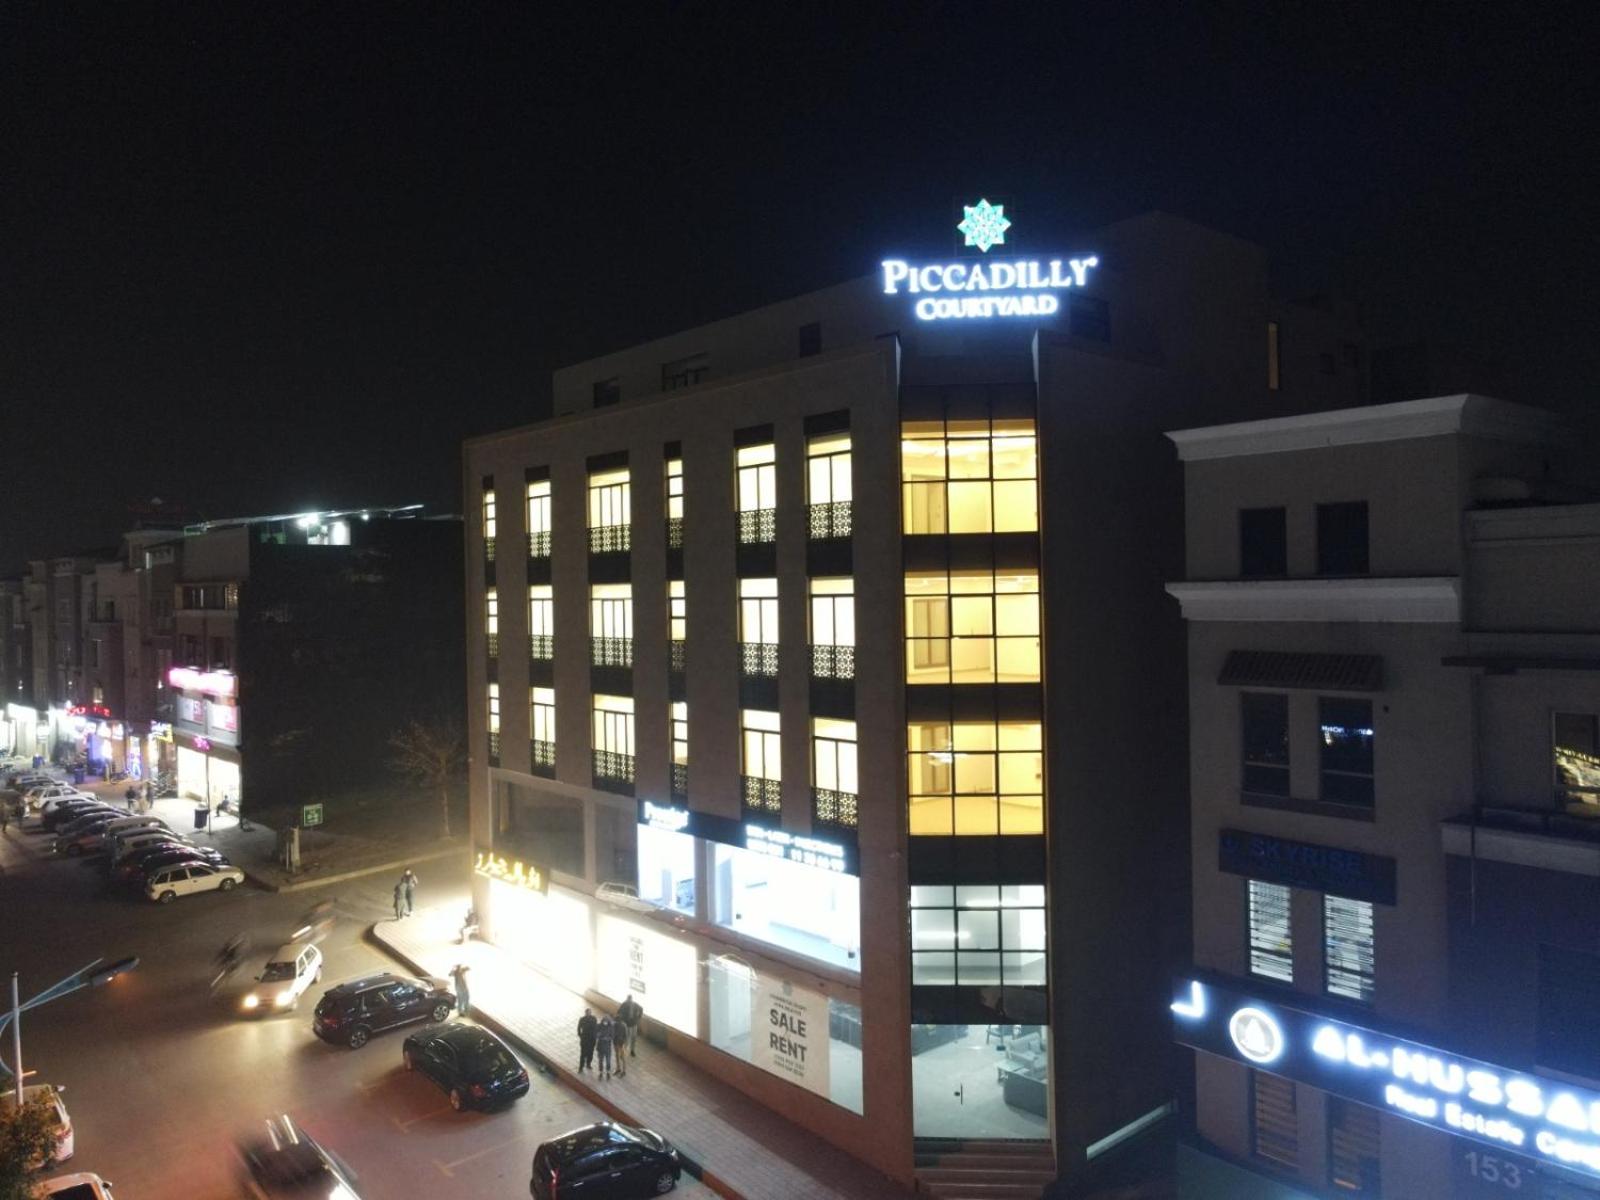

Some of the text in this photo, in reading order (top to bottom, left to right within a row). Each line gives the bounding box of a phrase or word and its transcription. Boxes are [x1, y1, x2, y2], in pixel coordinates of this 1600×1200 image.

[881, 259, 1091, 295] PICCADILLY
[916, 294, 1059, 320] COURTYARD
[769, 1008, 807, 1038] SALE
[769, 1032, 807, 1063] RENT
